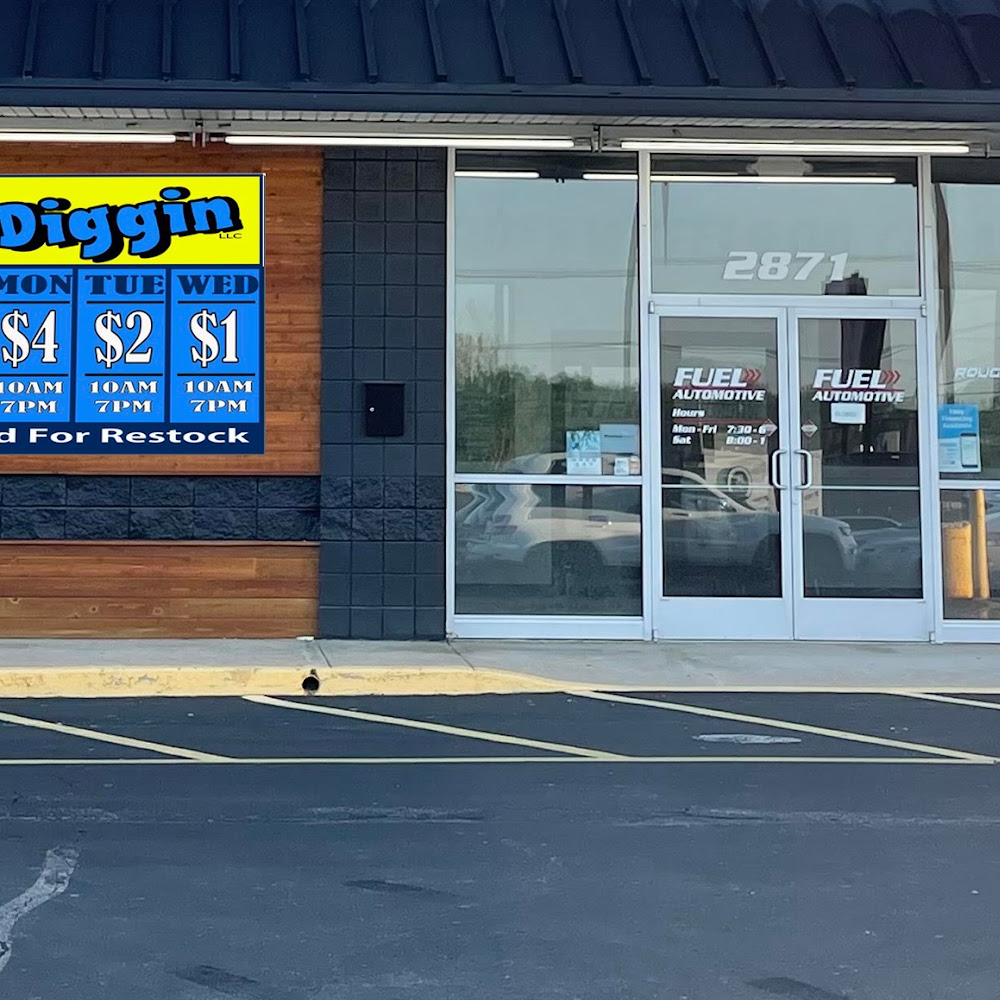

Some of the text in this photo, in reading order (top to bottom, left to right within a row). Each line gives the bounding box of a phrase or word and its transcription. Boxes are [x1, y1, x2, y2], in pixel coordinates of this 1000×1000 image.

[722, 251, 849, 281] 2871
[84, 274, 165, 295] TUE
[177, 274, 259, 295] WED
[0, 308, 59, 369] $4
[94, 308, 153, 369] $2
[189, 308, 239, 368] $1
[673, 367, 747, 388] FUEL
[813, 369, 887, 389] FUEL
[89, 380, 159, 394] 10AM
[184, 379, 253, 393] 10AM
[672, 389, 766, 401] AUTOMOTIVE
[812, 390, 905, 402] AUTOMOTIVE
[0, 400, 58, 413] 7PM
[94, 400, 152, 413] 7PM
[189, 399, 248, 412] 7PM
[672, 408, 706, 418] Hours
[29, 427, 90, 443] For
[101, 427, 250, 443] Restock
[672, 435, 691, 445] Sat
